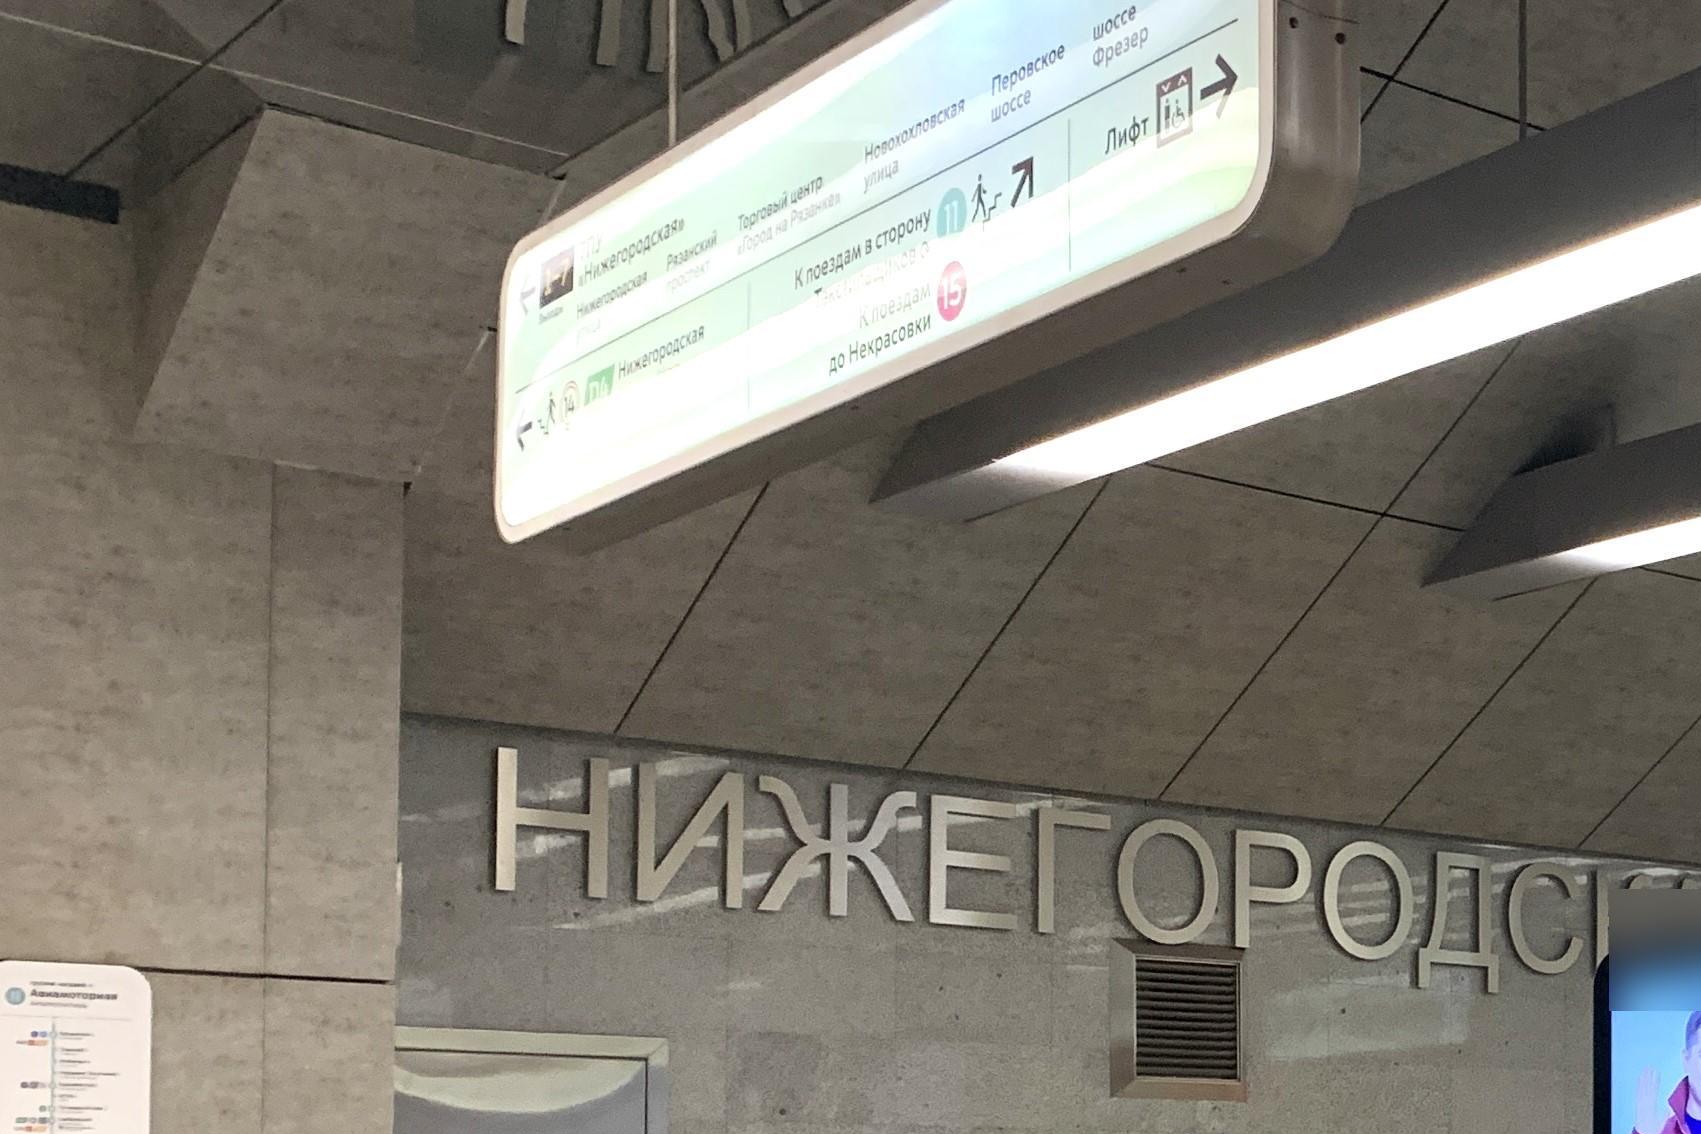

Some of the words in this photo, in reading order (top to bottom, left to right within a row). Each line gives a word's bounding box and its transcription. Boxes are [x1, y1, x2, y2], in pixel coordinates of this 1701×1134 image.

[1092, 4, 1137, 41] шоссе
[1092, 25, 1149, 68] Фрезер
[991, 43, 1066, 97] Перовское
[864, 97, 966, 164] Новохохловская
[990, 90, 1032, 124] шоссе
[1104, 115, 1150, 155] Лифт
[863, 158, 900, 194] улица
[738, 191, 788, 232] Торговый
[790, 175, 824, 206] центр
[666, 229, 718, 272] Рязанский
[794, 269, 804, 290] К
[806, 244, 862, 284] поездам
[864, 239, 873, 255] в
[875, 208, 932, 251] сторону
[576, 271, 648, 320] Нижегородская
[859, 305, 869, 329] К
[871, 281, 931, 322] поездам
[618, 325, 705, 380] Нижегородская
[828, 352, 845, 376] до
[849, 313, 932, 365] Некрасовки
